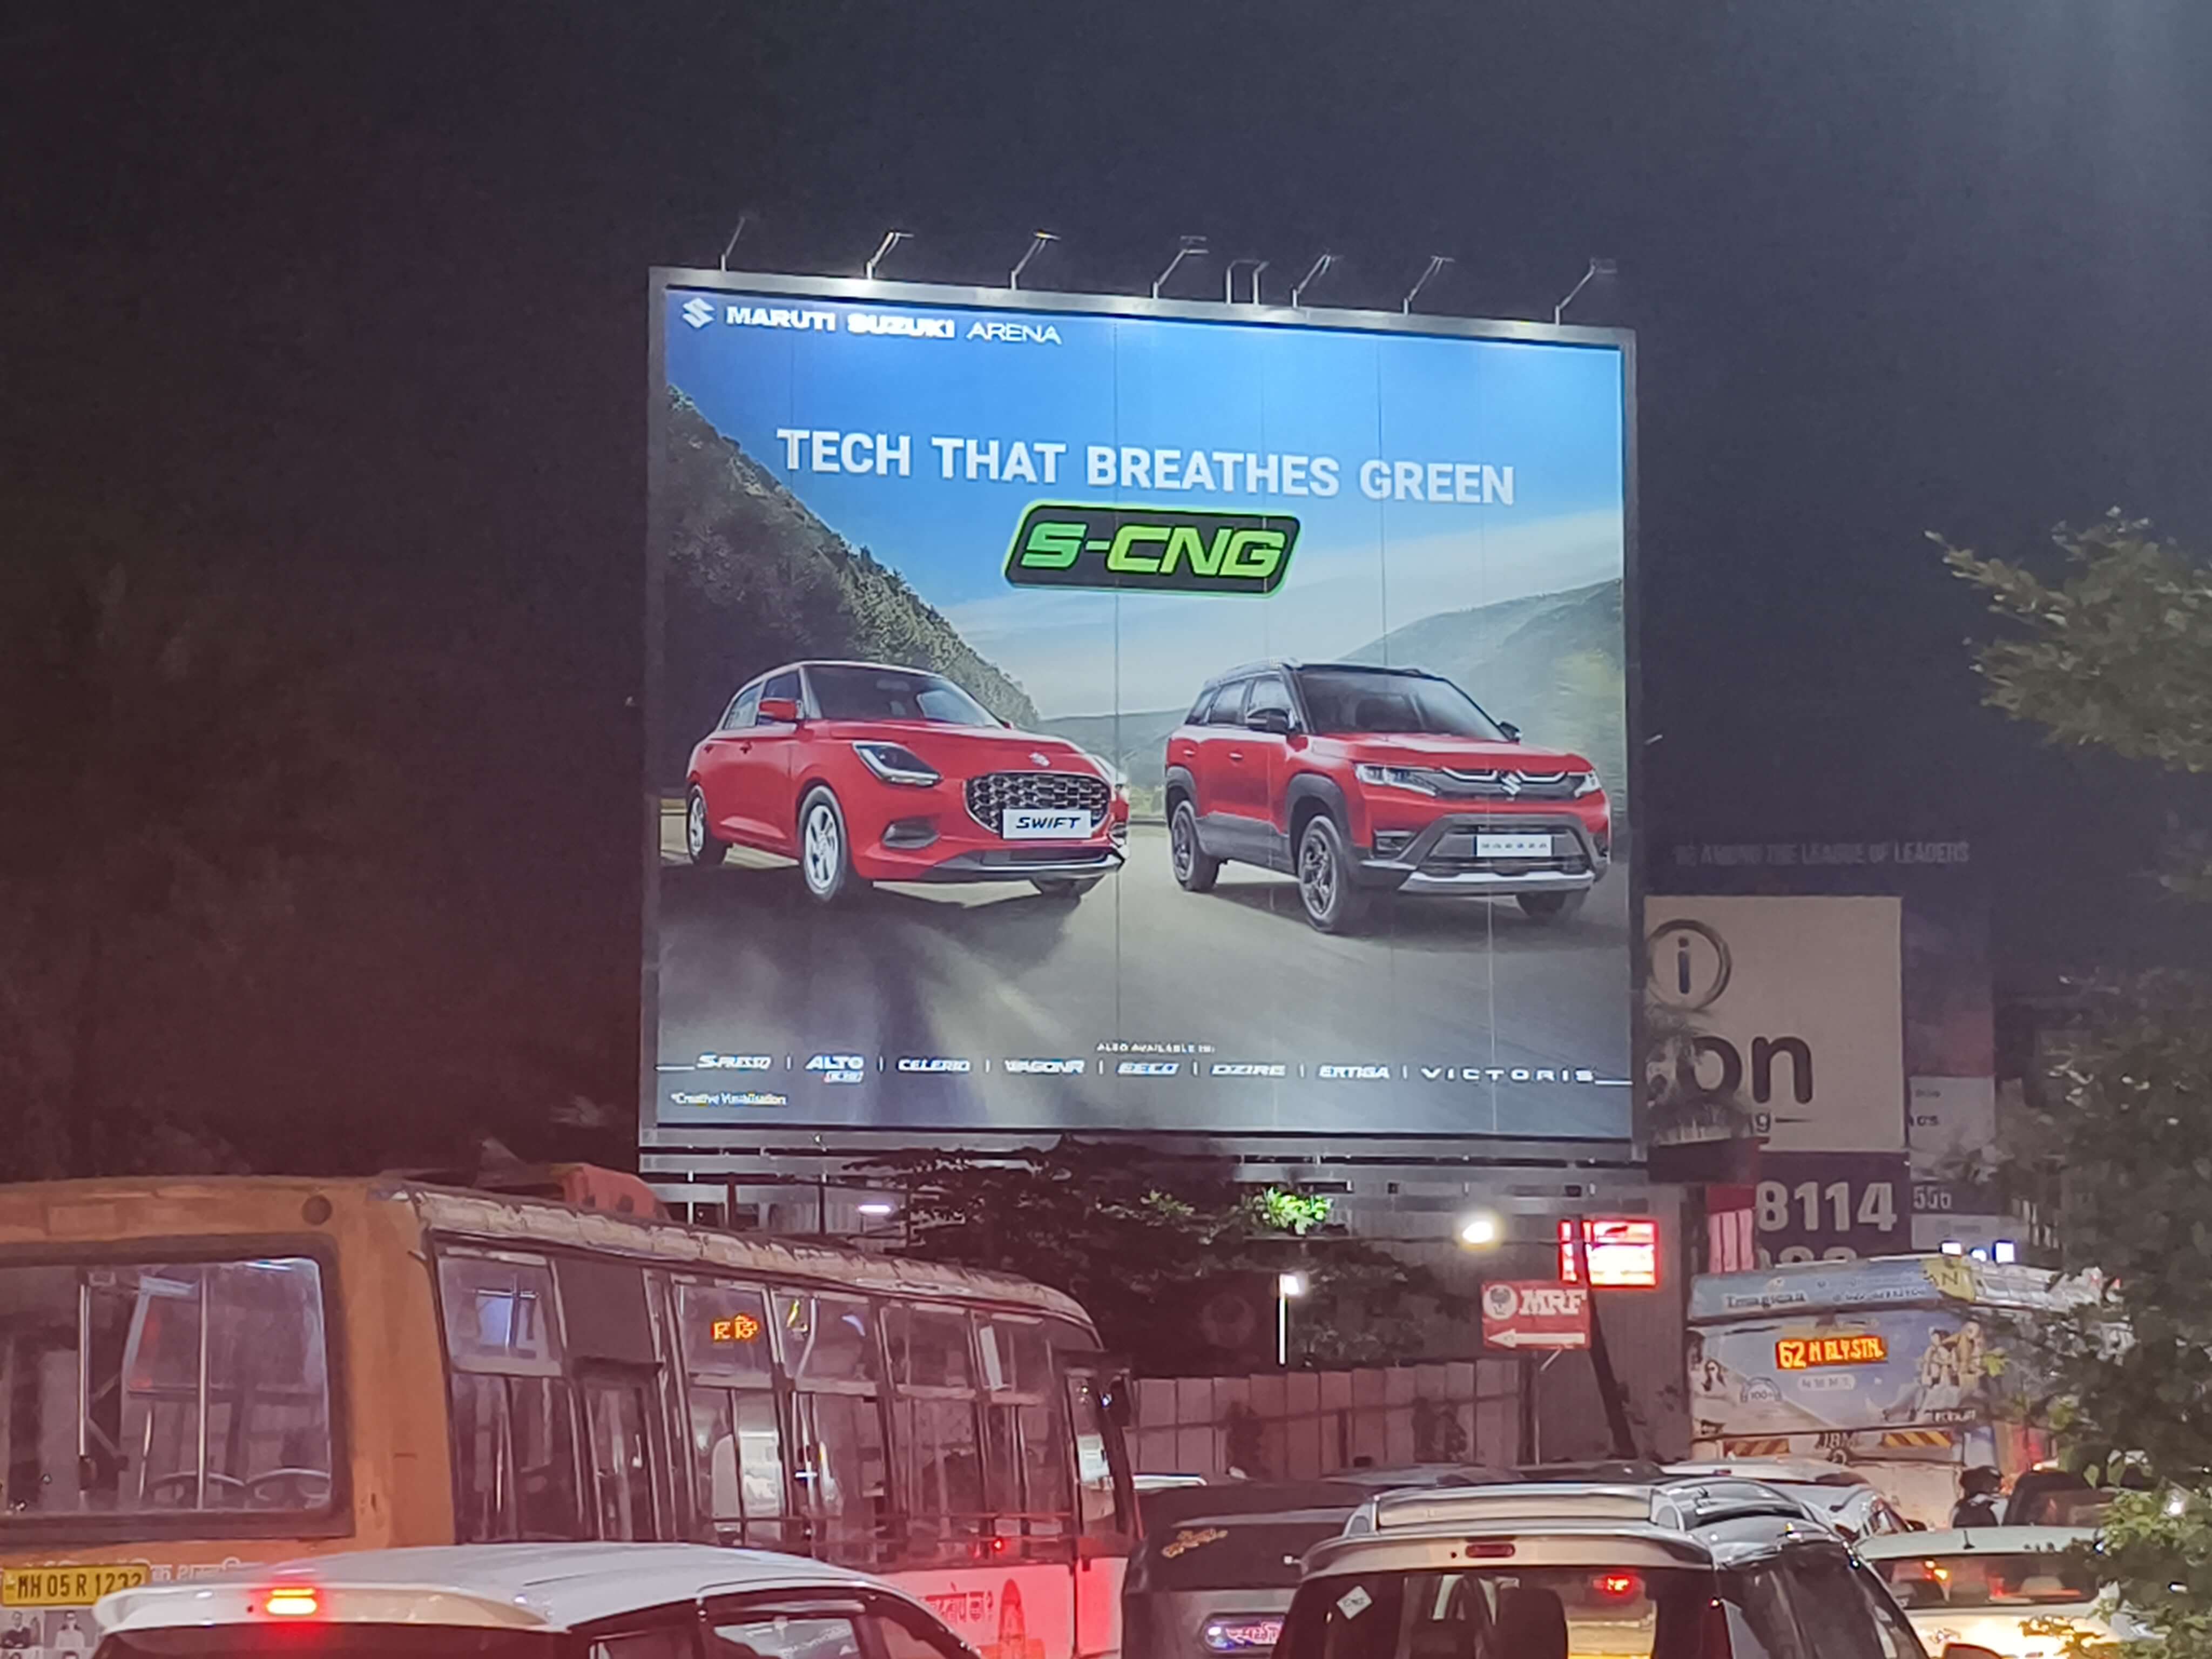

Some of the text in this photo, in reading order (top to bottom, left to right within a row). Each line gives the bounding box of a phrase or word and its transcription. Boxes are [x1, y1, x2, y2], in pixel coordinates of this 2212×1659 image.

[726, 306, 1062, 344] MARUTI SUZUKI ARENA
[777, 428, 1514, 505] TECH THAT BREATHES GREEN
[1021, 522, 1286, 577] S-CNG
[1016, 817, 1081, 828] SWIFT
[805, 1055, 864, 1070] ALTO
[1421, 1068, 1595, 1082] VICTORIS
[1758, 1181, 1897, 1232] 8114
[1519, 1289, 1587, 1315] MRF
[1779, 1341, 1808, 1368] 62
[17, 1574, 42, 1599] MH
[47, 1573, 70, 1597] 05
[76, 1573, 87, 1597] R
